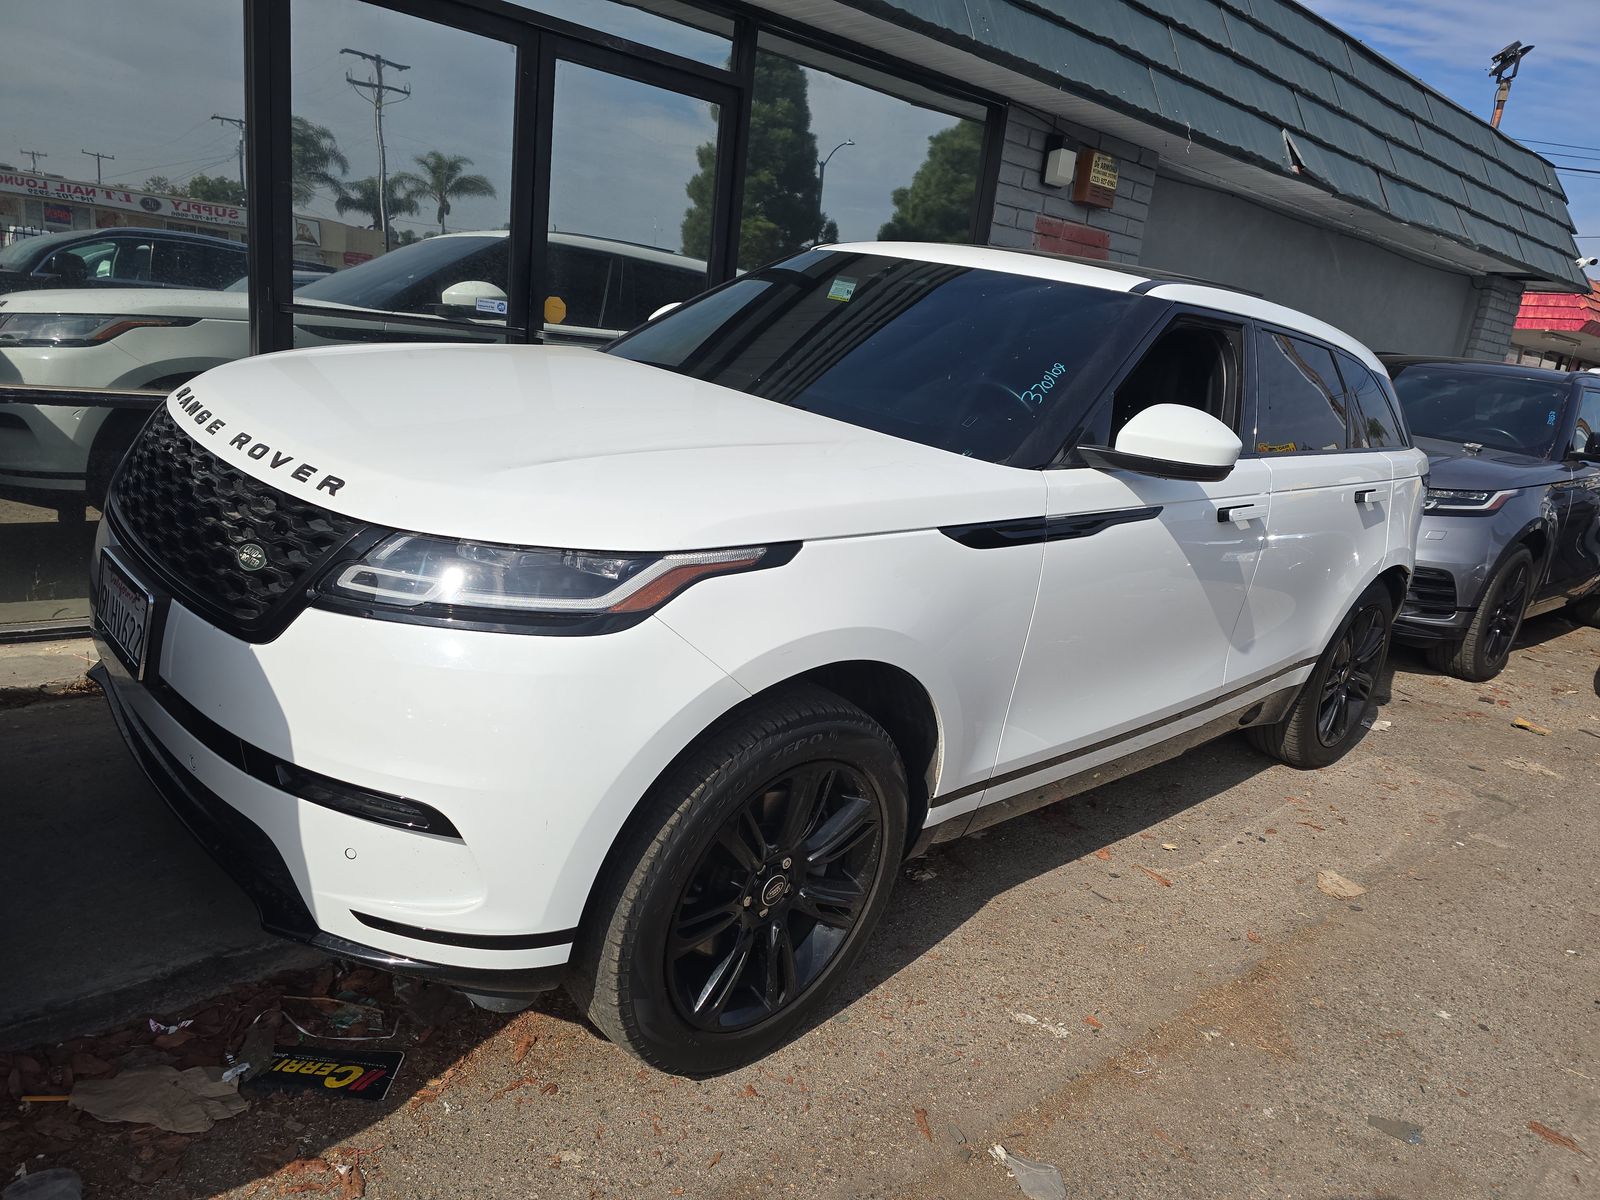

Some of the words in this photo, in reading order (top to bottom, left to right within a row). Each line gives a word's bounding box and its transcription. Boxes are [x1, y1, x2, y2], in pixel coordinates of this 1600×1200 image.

[175, 386, 226, 436] RANGE
[228, 431, 346, 497] ROVER
[243, 545, 260, 558] LAND
[240, 552, 260, 567] ROVER
